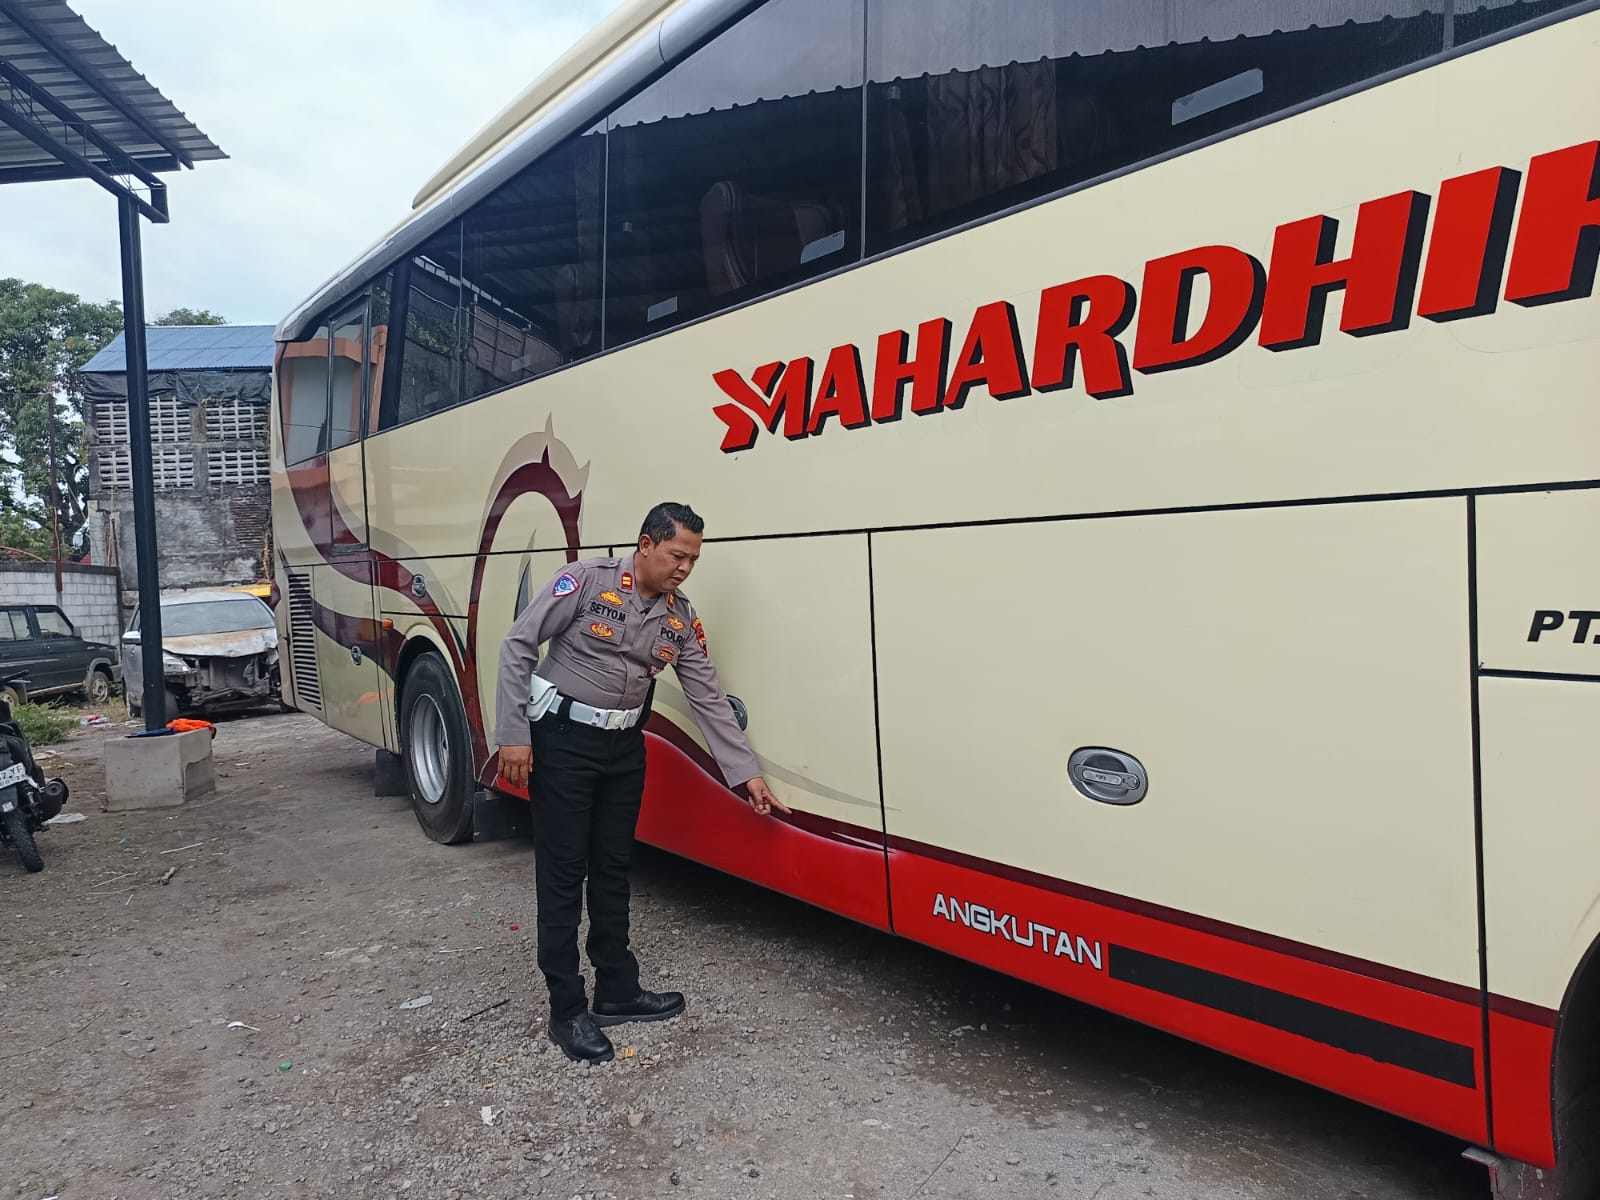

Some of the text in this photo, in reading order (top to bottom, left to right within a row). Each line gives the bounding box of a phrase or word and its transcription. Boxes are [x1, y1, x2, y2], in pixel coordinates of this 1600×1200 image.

[589, 601, 626, 623] SETYO.M
[660, 627, 685, 647] POLRI
[1527, 610, 1600, 644] PT.
[932, 892, 1103, 970] ANGKUTAN
